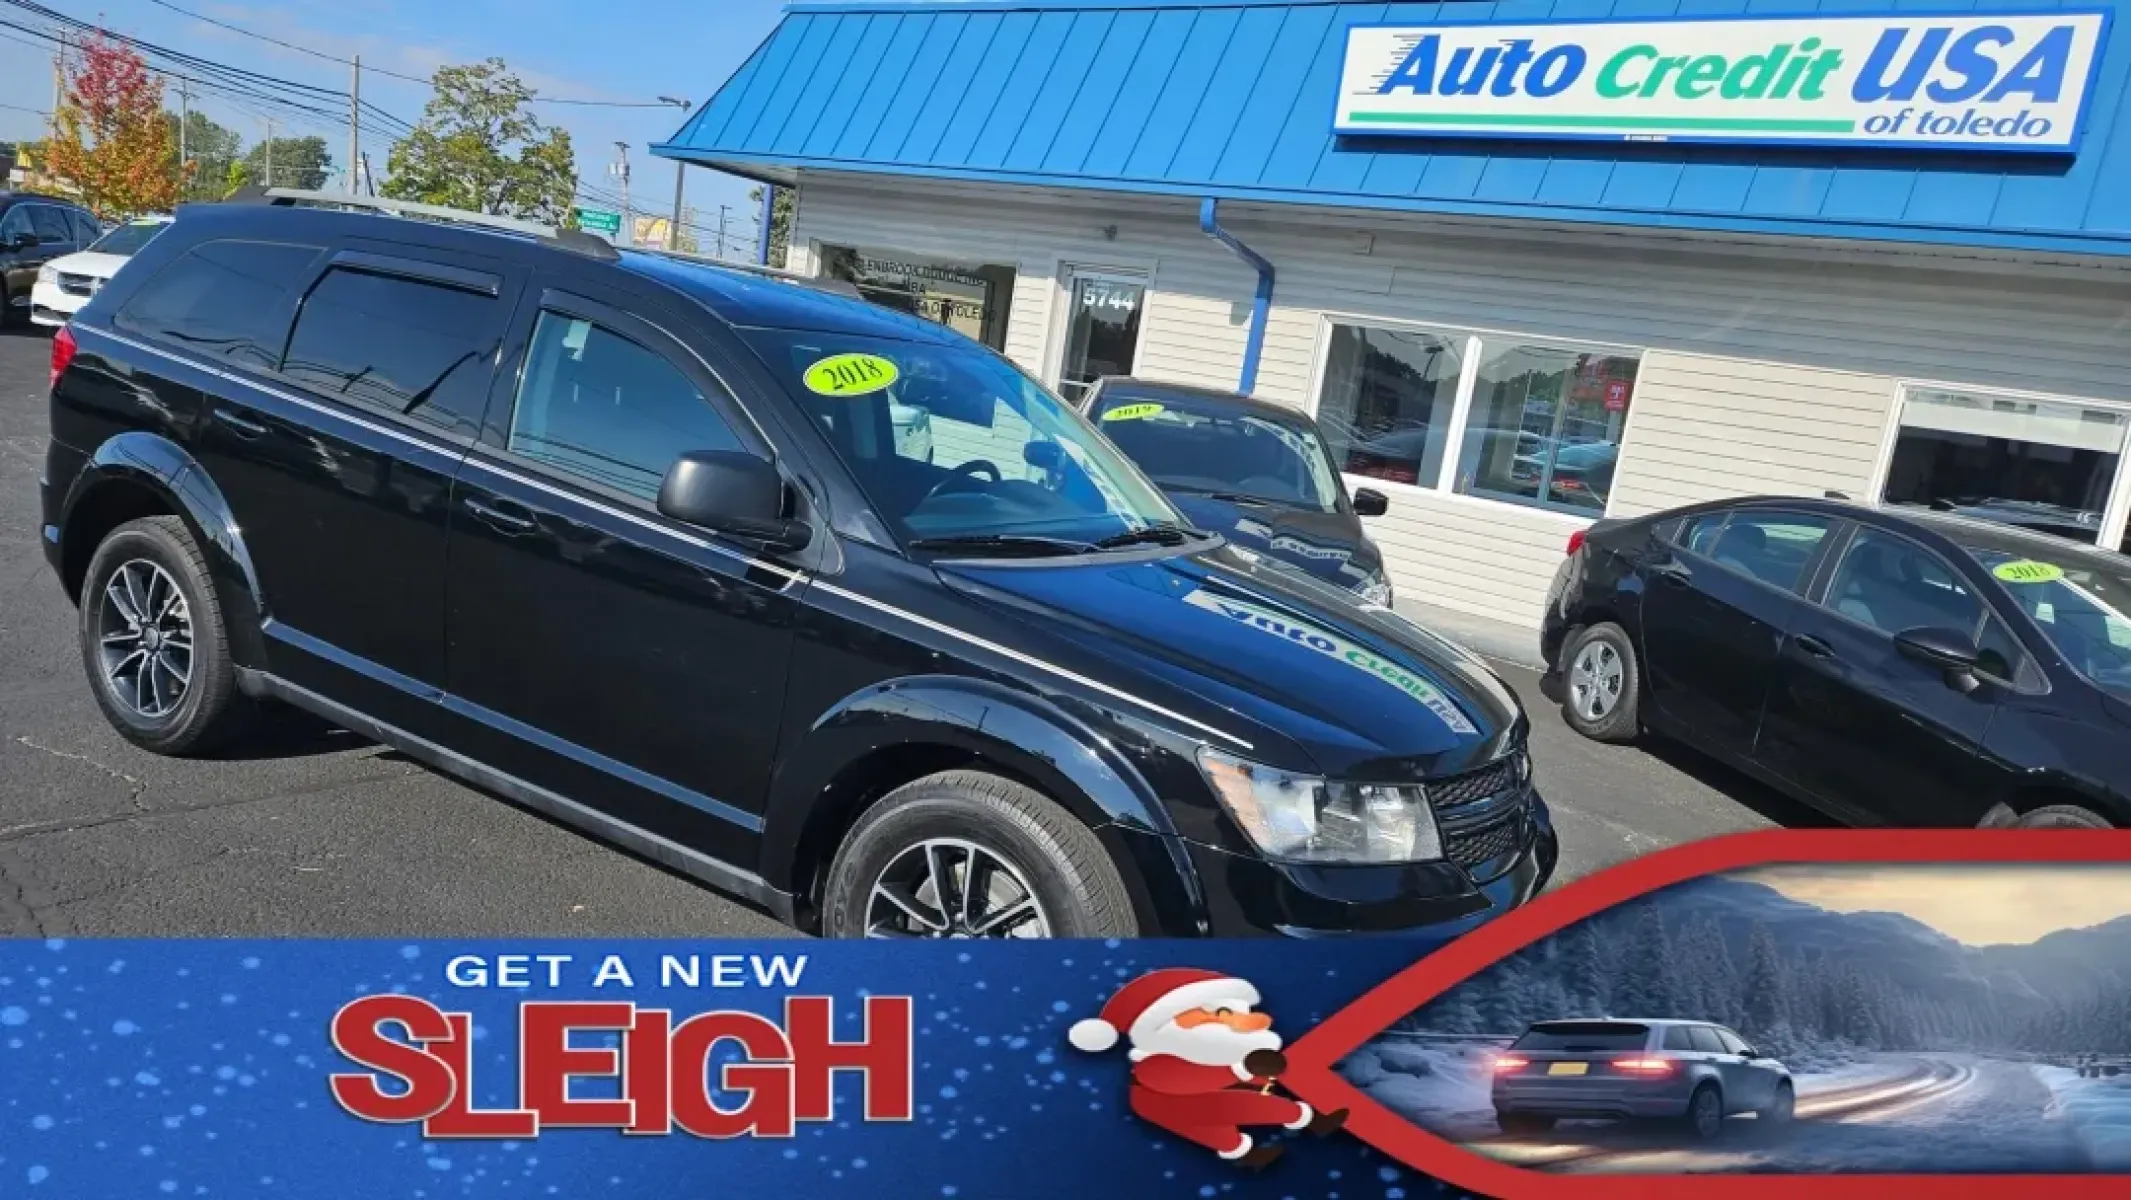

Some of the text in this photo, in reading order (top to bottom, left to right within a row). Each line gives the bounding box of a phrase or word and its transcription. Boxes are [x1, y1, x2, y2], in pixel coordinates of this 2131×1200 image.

[1371, 25, 2075, 103] Auto Credit USA
[1863, 108, 2052, 137] of toledo
[1083, 287, 1135, 311] 5744
[823, 359, 882, 391] 2018
